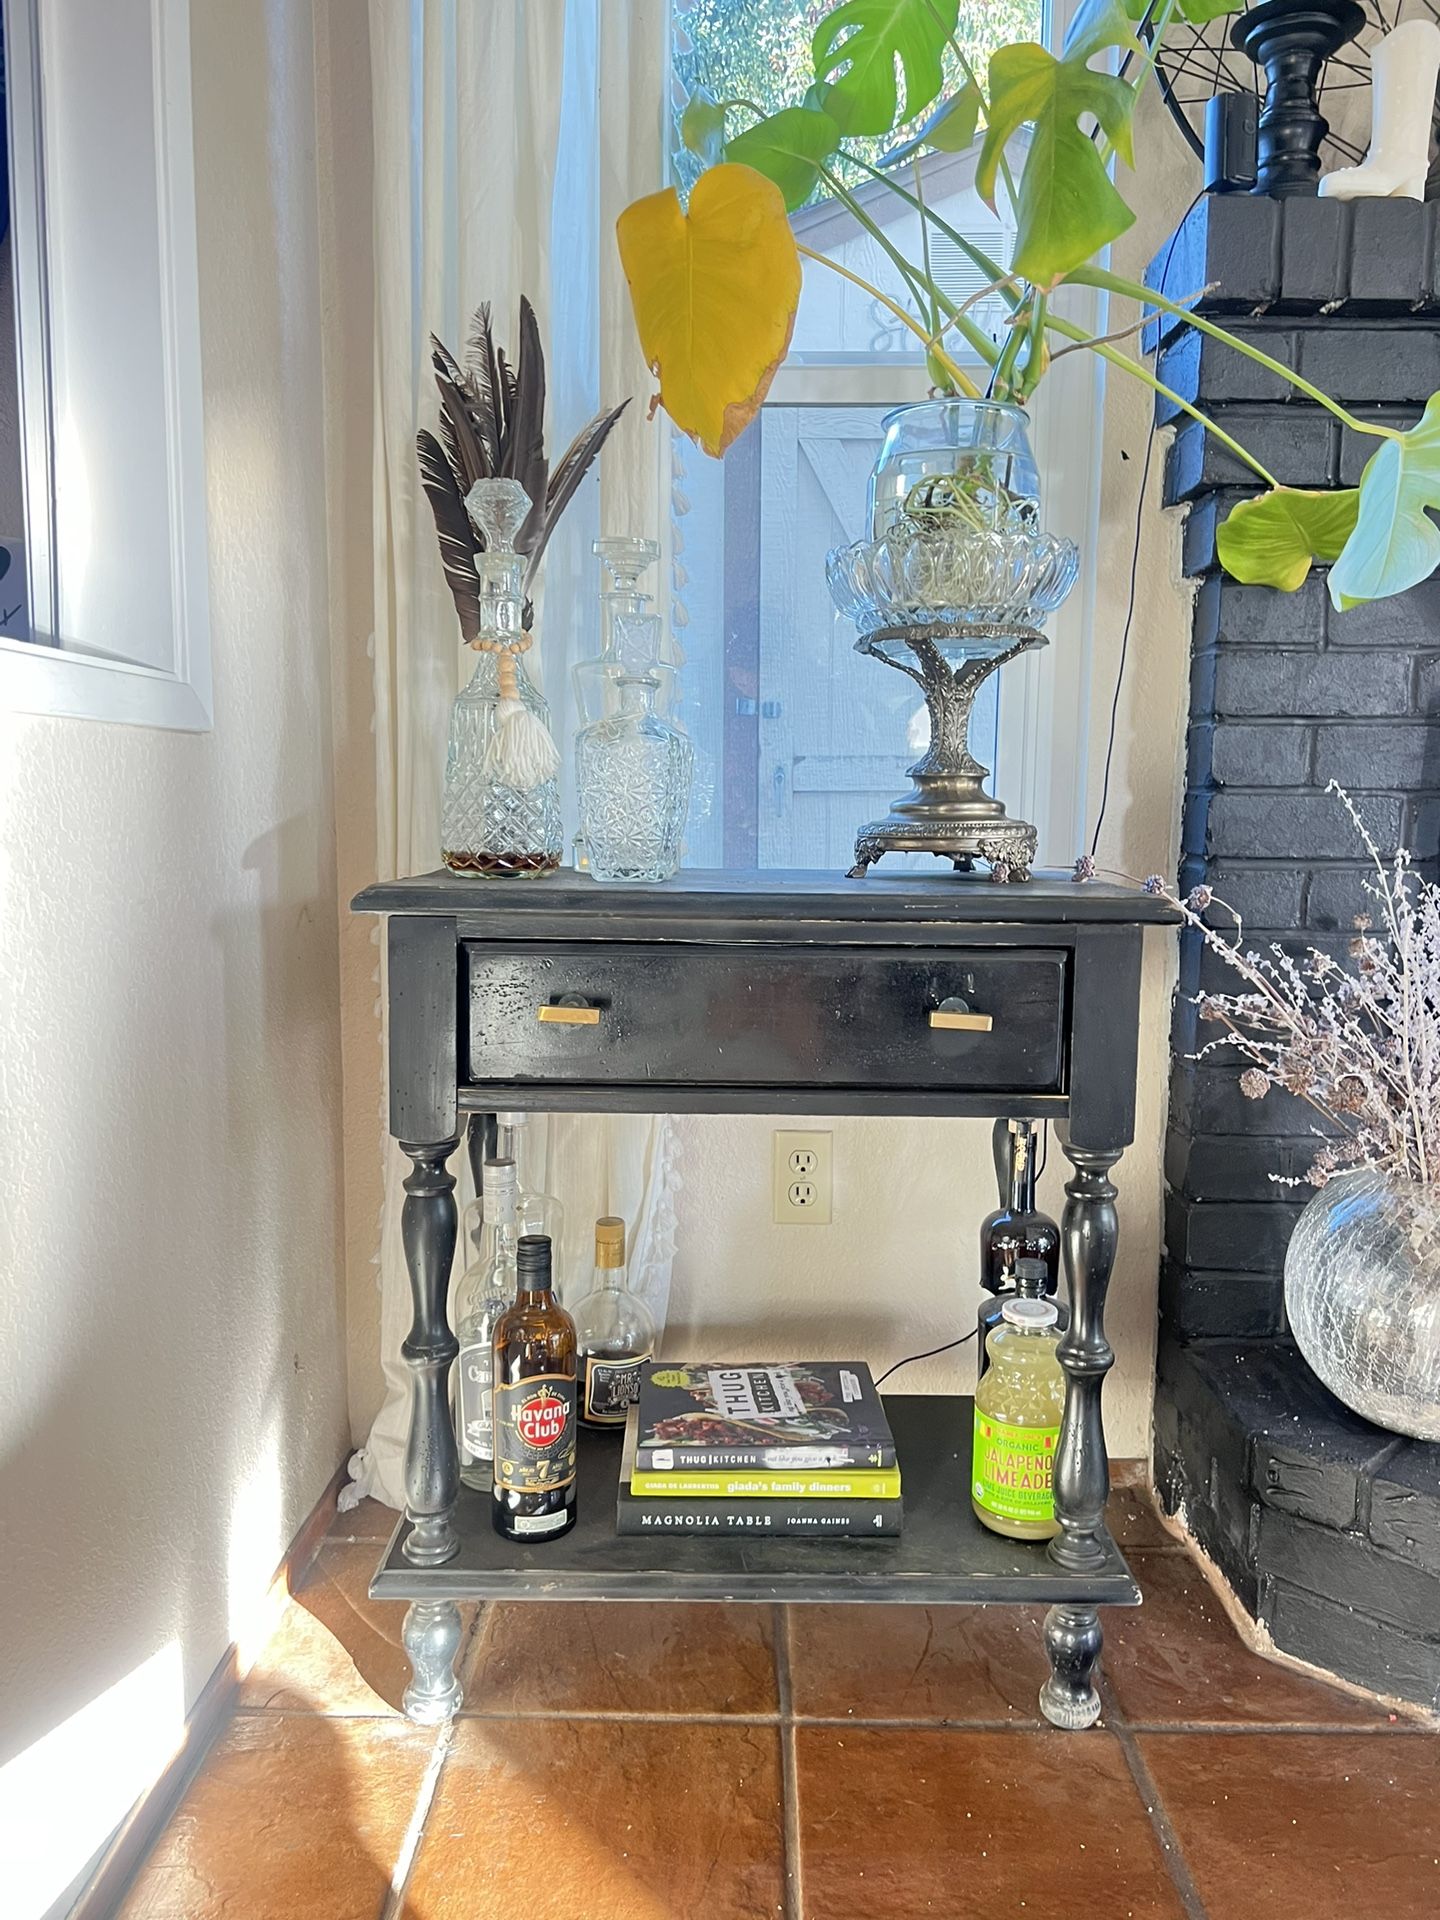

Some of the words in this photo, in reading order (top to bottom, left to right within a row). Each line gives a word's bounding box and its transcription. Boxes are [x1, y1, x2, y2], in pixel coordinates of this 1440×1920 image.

[719, 1372, 751, 1415] THUG
[752, 1372, 776, 1413] KITCHEN
[511, 1401, 570, 1422] Havana
[523, 1419, 560, 1438] Club
[996, 1438, 1039, 1451] ORGANIC
[713, 1455, 757, 1464] KITCHEN
[536, 1460, 550, 1479] 7
[727, 1480, 768, 1493] giada's
[771, 1481, 806, 1494] family
[809, 1481, 851, 1492] dinners
[1018, 1489, 1055, 1500] BEVERAG
[641, 1515, 720, 1526] MAGNOLIA
[727, 1515, 772, 1526] TABLE
[786, 1517, 818, 1525] JOANNA
[821, 1517, 850, 1525] GAINES
